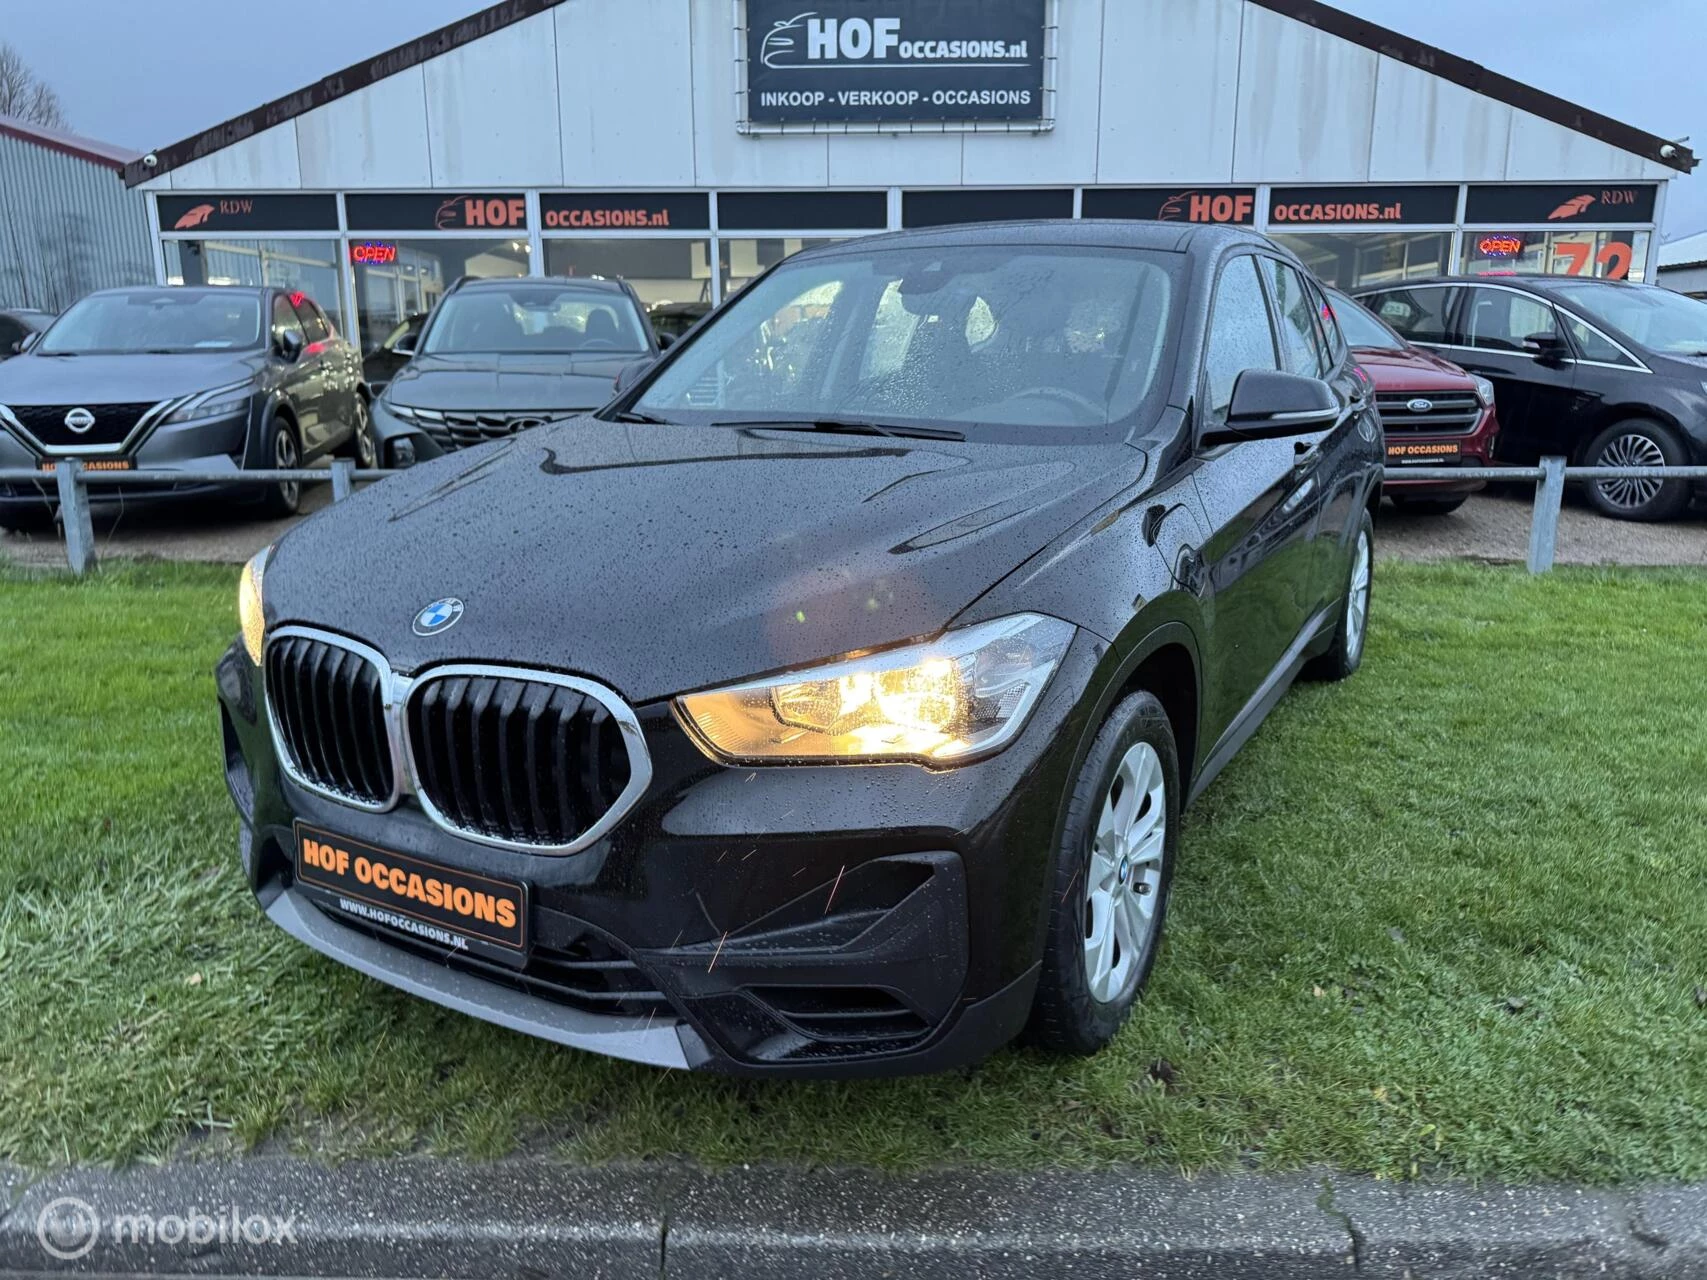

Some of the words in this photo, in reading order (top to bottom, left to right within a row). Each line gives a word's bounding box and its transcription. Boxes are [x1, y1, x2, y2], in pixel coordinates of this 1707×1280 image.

[807, 18, 900, 59] HOF
[899, 40, 1028, 58] OCCASIONS.nl
[761, 92, 825, 106] INKOOP
[838, 91, 919, 105] VERKOOP
[932, 90, 1031, 105] OCCASIONS
[1601, 190, 1635, 204] RDW
[220, 200, 253, 214] RDW
[465, 199, 525, 226] HOF
[545, 209, 669, 227] OCCASIONS.nl
[1190, 195, 1253, 221] HOF
[1274, 203, 1402, 221] OCCASIONS.nl
[354, 245, 396, 262] OPEN
[1480, 239, 1521, 253] OPEN
[1555, 241, 1632, 281] 72
[1388, 447, 1406, 455] HOF
[1407, 445, 1458, 454] OCCASIONS
[42, 463, 57, 472] HO
[302, 838, 350, 876] HOF
[354, 857, 517, 929] OCCASIONS
[339, 898, 469, 950] WWW.HOFOCCASIONS.NL
